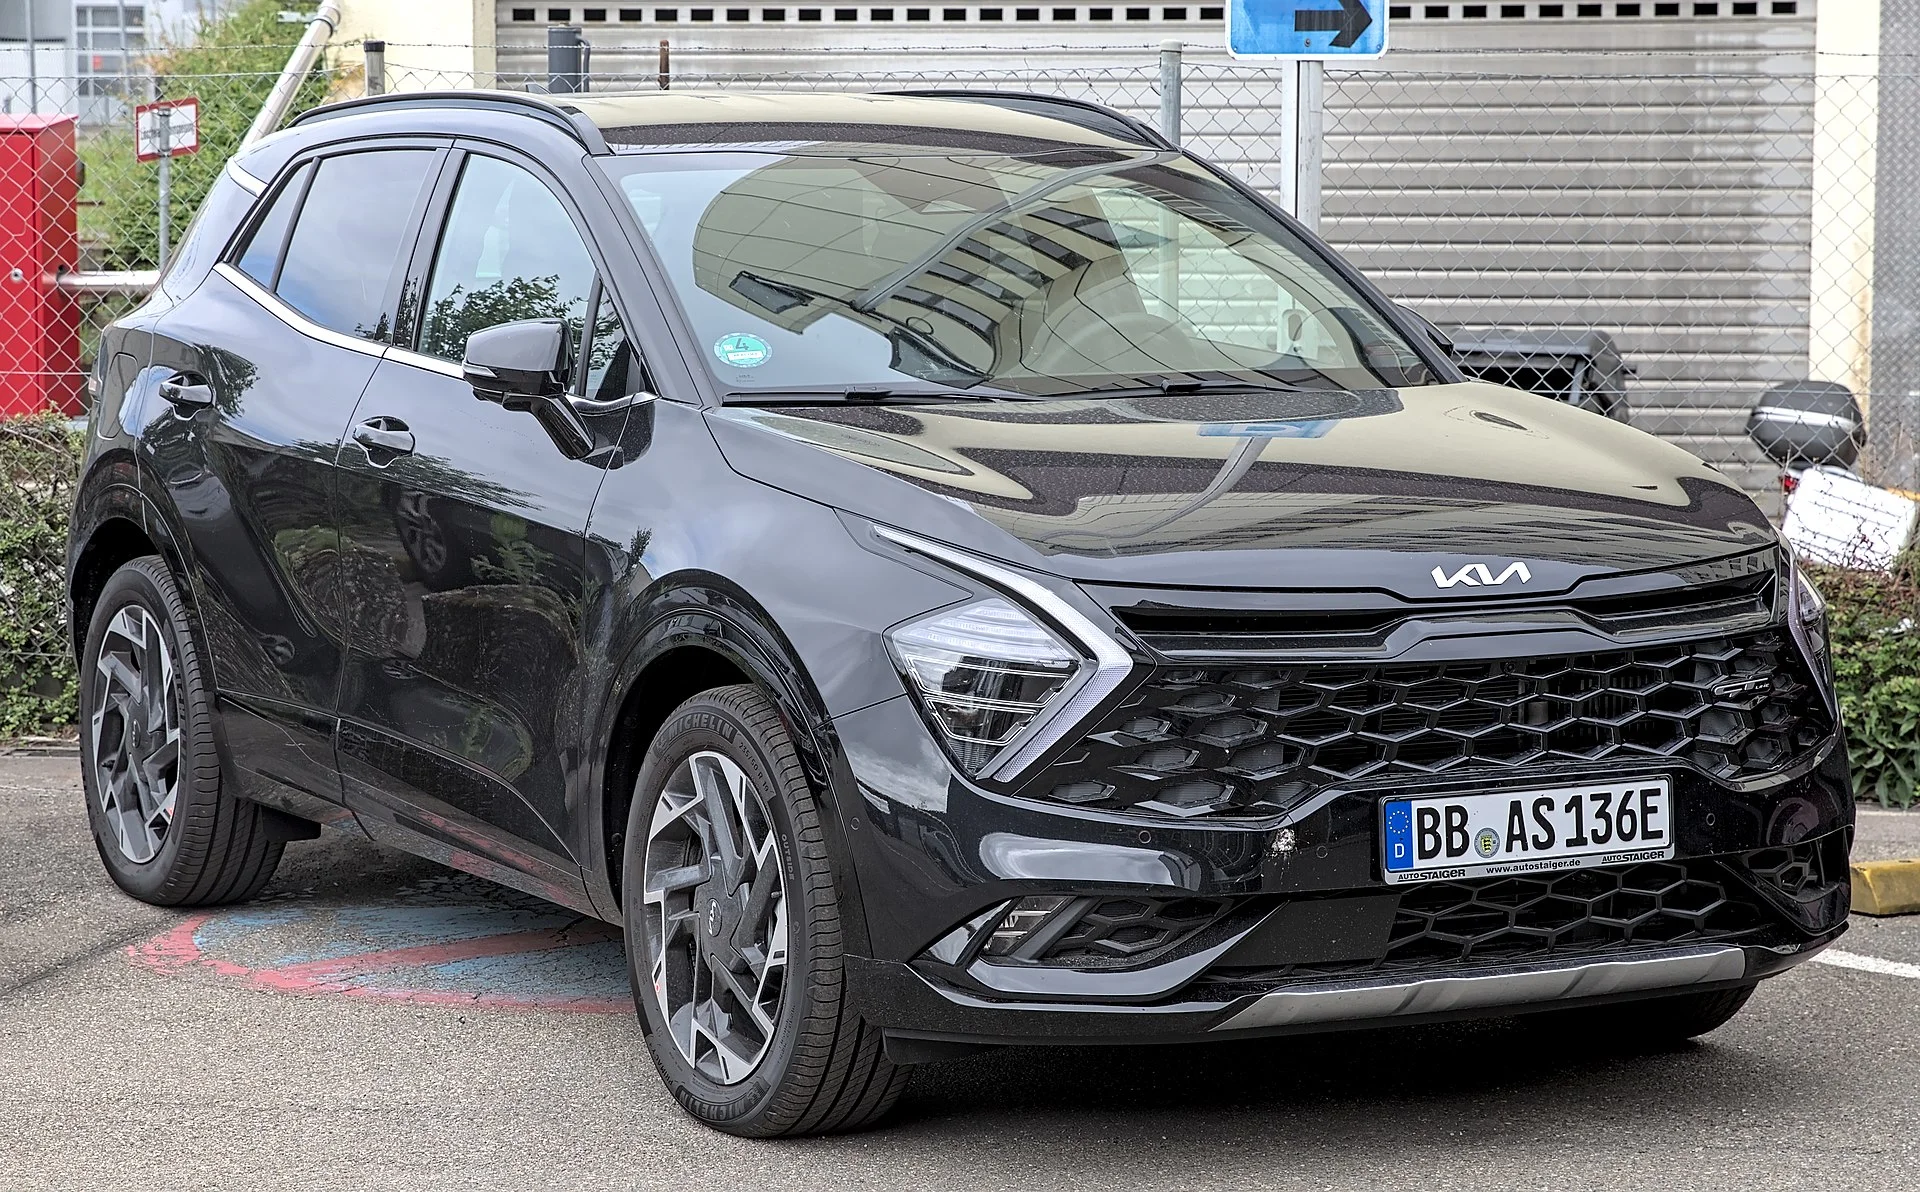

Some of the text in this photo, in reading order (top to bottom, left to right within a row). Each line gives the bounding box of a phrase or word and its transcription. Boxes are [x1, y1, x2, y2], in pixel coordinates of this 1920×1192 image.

[736, 337, 750, 351] 4
[1431, 561, 1532, 589] KIA
[669, 713, 734, 741] MICHELIN
[738, 741, 759, 771] 235/50
[1416, 804, 1470, 860] BB
[1505, 797, 1556, 853] AS
[1564, 787, 1664, 848] 136E
[781, 833, 795, 881] OUTSIDE
[1394, 843, 1405, 858] D
[1486, 859, 1581, 874] www.autostaiger.de
[679, 1089, 746, 1121] MICHELIN
